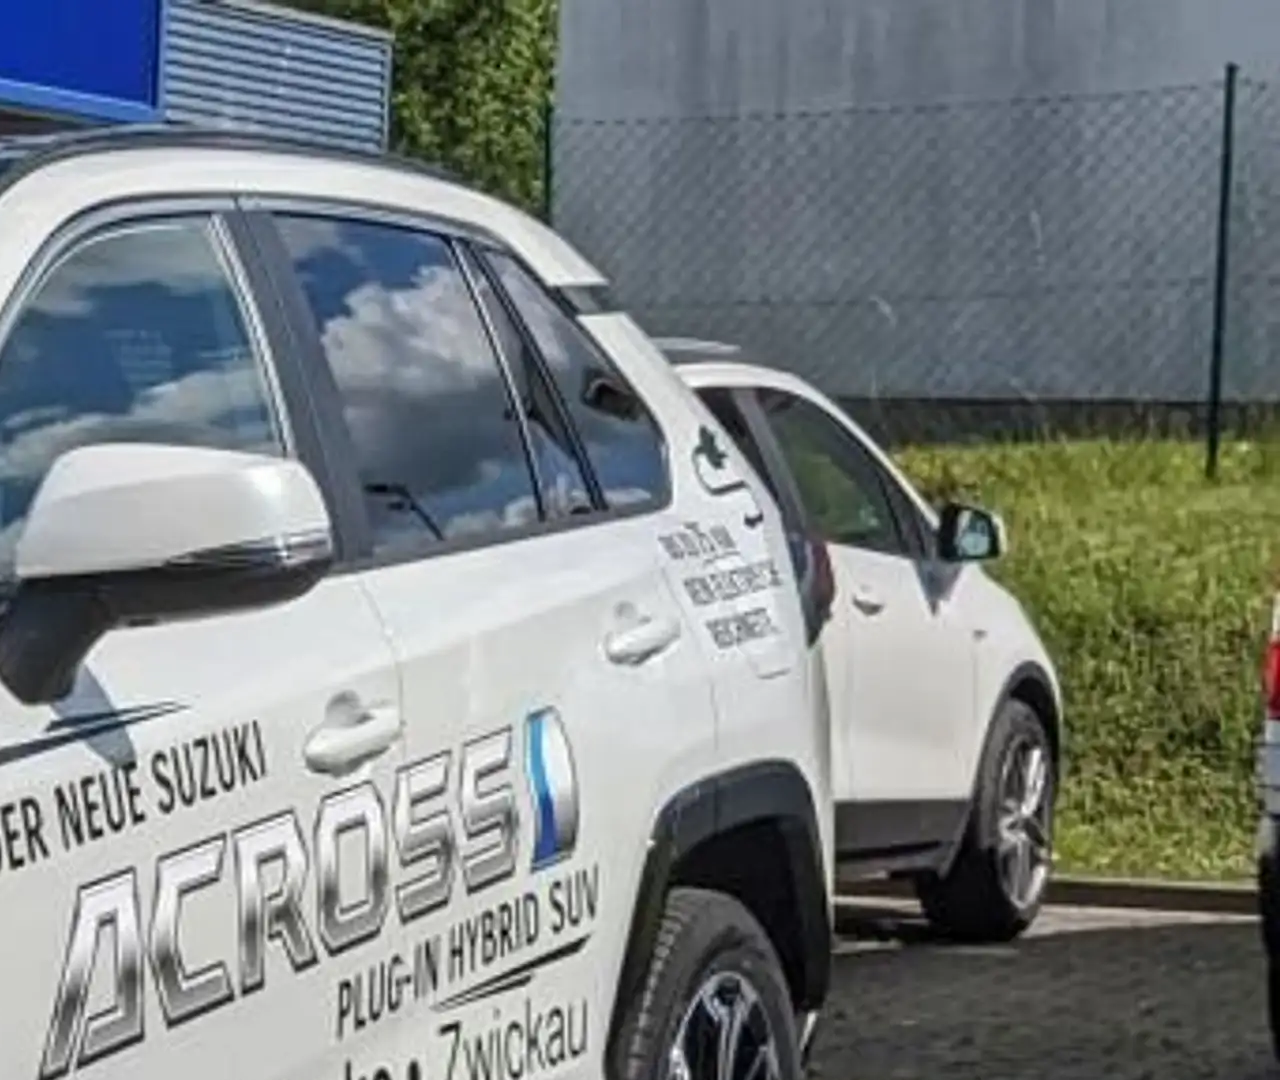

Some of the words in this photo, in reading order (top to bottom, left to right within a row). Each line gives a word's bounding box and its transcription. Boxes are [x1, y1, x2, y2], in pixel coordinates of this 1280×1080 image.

[54, 761, 144, 850] NEUE
[151, 720, 267, 815] SUZUKI
[338, 937, 442, 1041] PLUG-IN
[449, 890, 540, 982] HYBRID
[549, 865, 600, 936] SUV
